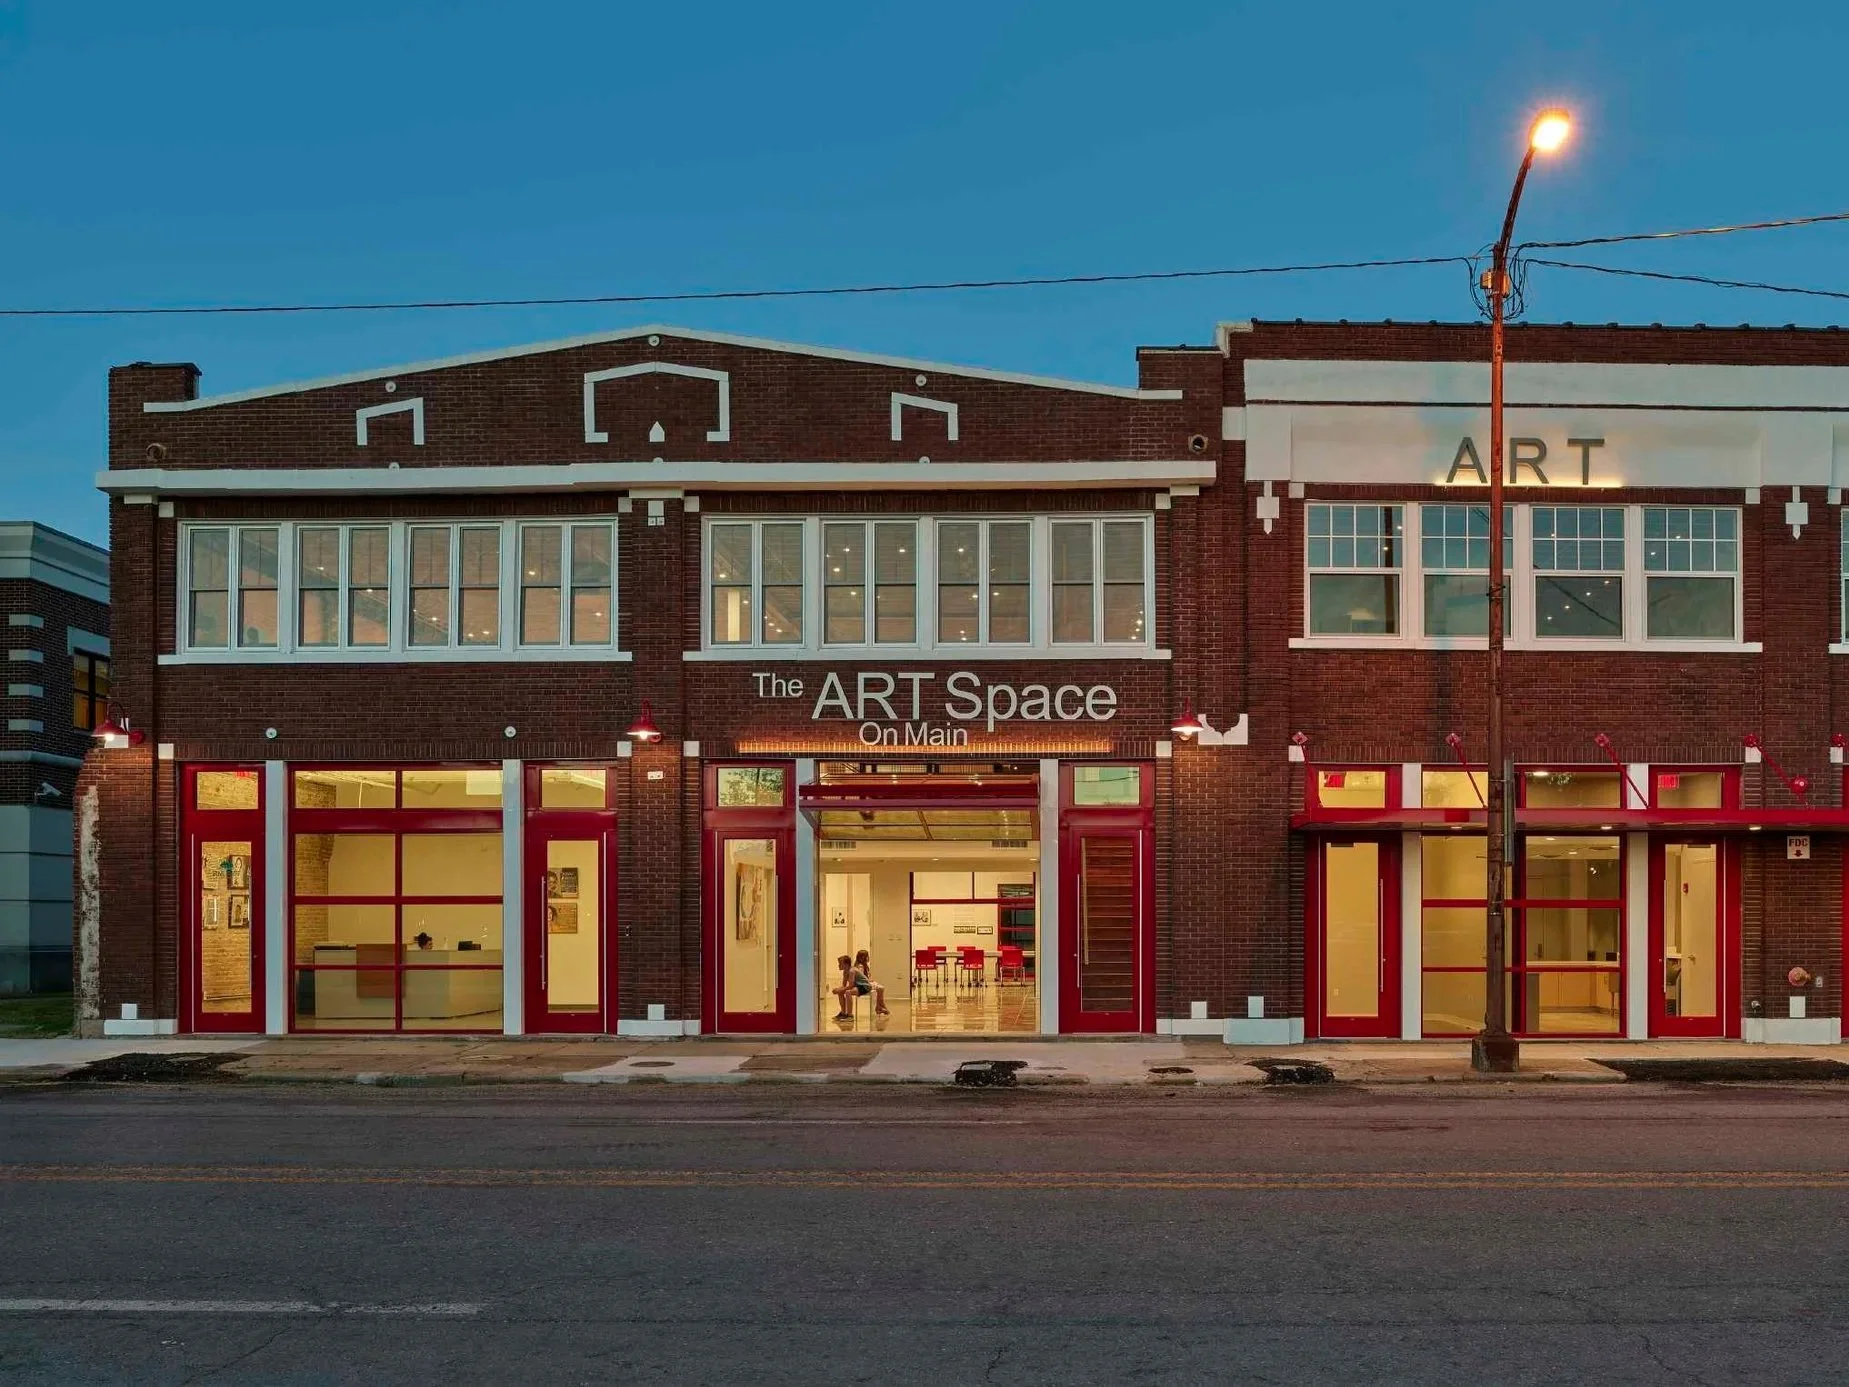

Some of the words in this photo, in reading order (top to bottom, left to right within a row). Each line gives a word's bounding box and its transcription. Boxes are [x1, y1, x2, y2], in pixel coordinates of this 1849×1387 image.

[1446, 437, 1605, 486] ART
[752, 672, 804, 698] The
[811, 671, 936, 721] ART
[944, 671, 1117, 733] Space
[858, 721, 898, 746] On
[904, 721, 968, 746] Main
[1788, 838, 1809, 847] FDC
